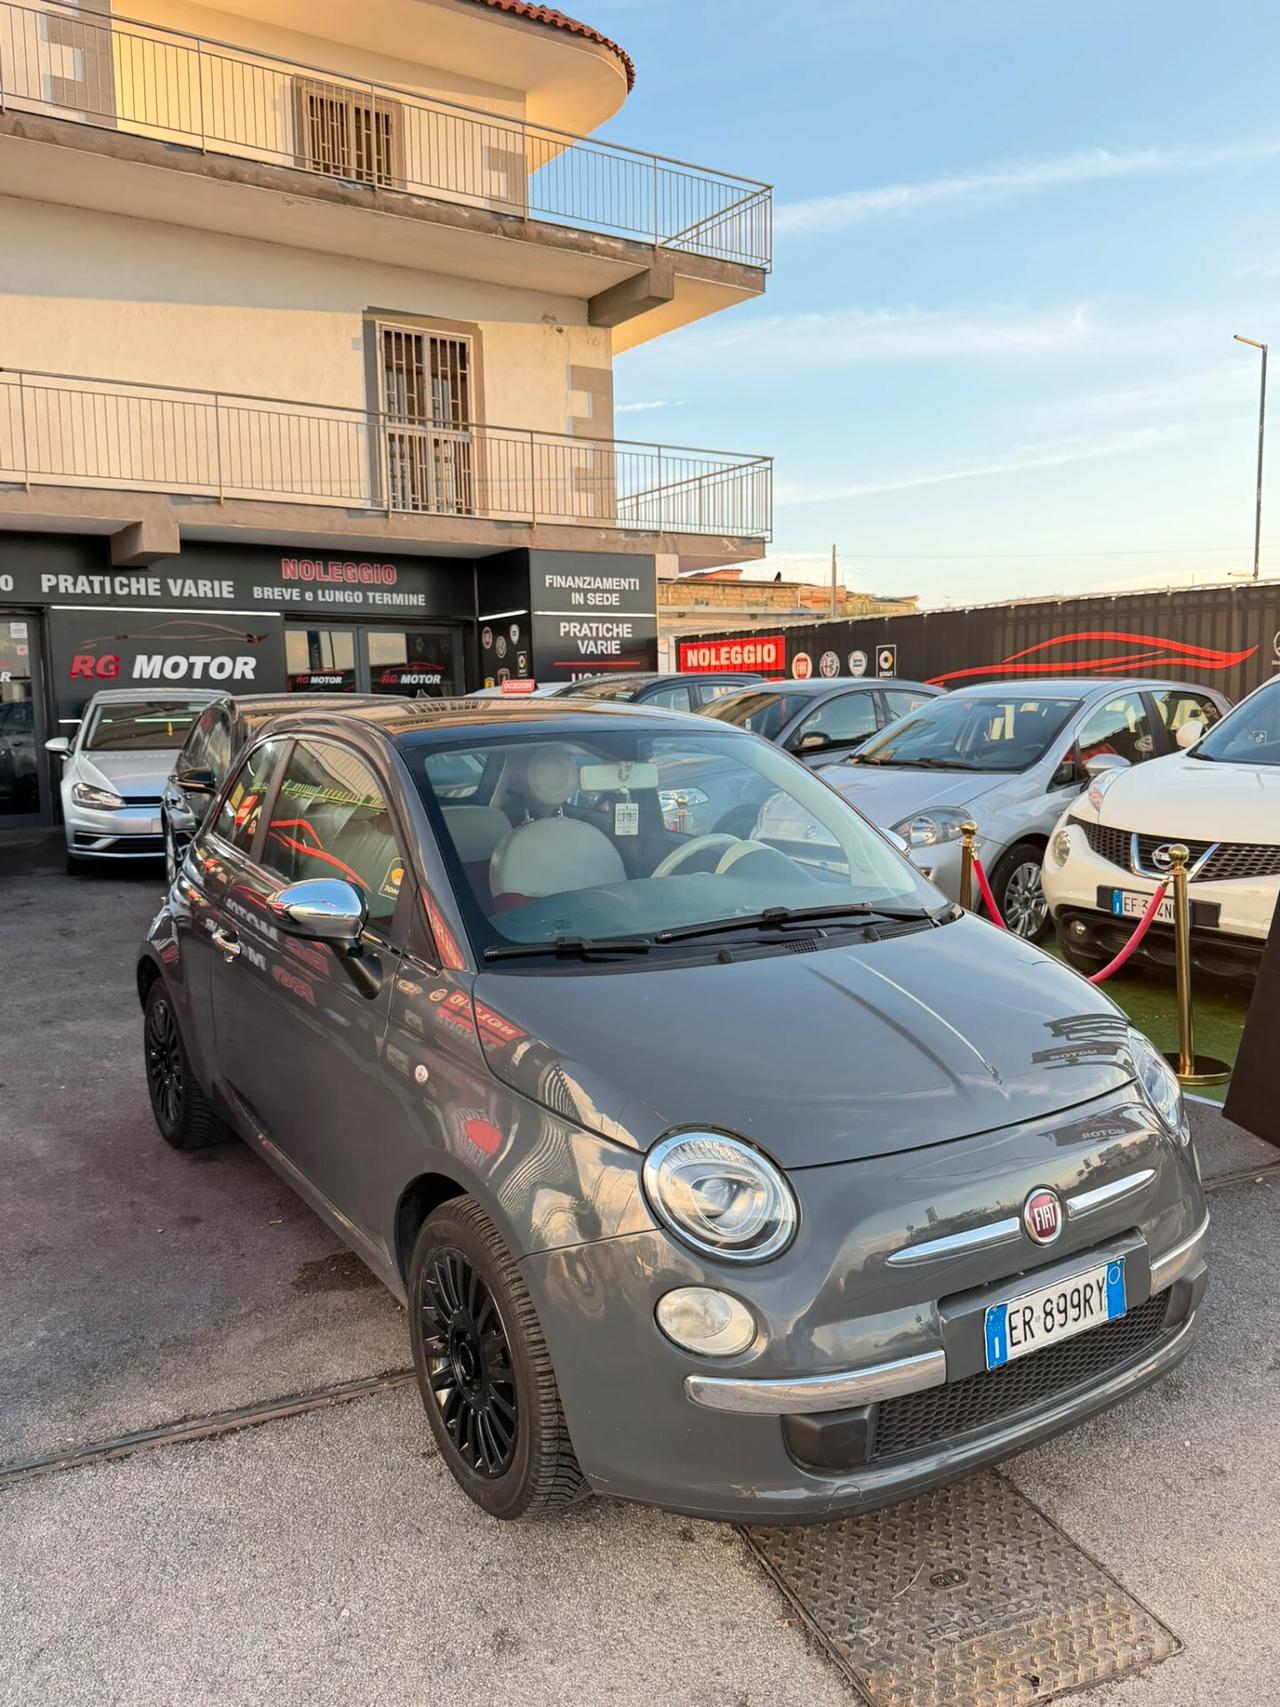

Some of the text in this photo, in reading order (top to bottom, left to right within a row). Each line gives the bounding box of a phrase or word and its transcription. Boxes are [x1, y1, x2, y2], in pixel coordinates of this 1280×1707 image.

[281, 558, 397, 586] NOLEGGIO
[41, 573, 162, 597] PRATICHE
[167, 578, 235, 598] VARIE
[545, 575, 640, 591] FINANZIAMENTI
[253, 586, 426, 606] BREVE e LUNGO TERMINE
[571, 592, 620, 606] IN SEDE
[559, 622, 633, 638] PRATICHE
[577, 640, 621, 655] VARIE
[687, 643, 776, 667] NOLEGGIO
[69, 654, 257, 680] RG MOTOR
[310, 676, 342, 685] MOTOR
[381, 674, 442, 685] RG MOTOR
[1123, 896, 1138, 912] EF
[1033, 1203, 1056, 1231] FIAT
[1008, 1306, 1035, 1348] ER
[1042, 1277, 1106, 1334] 899RY
